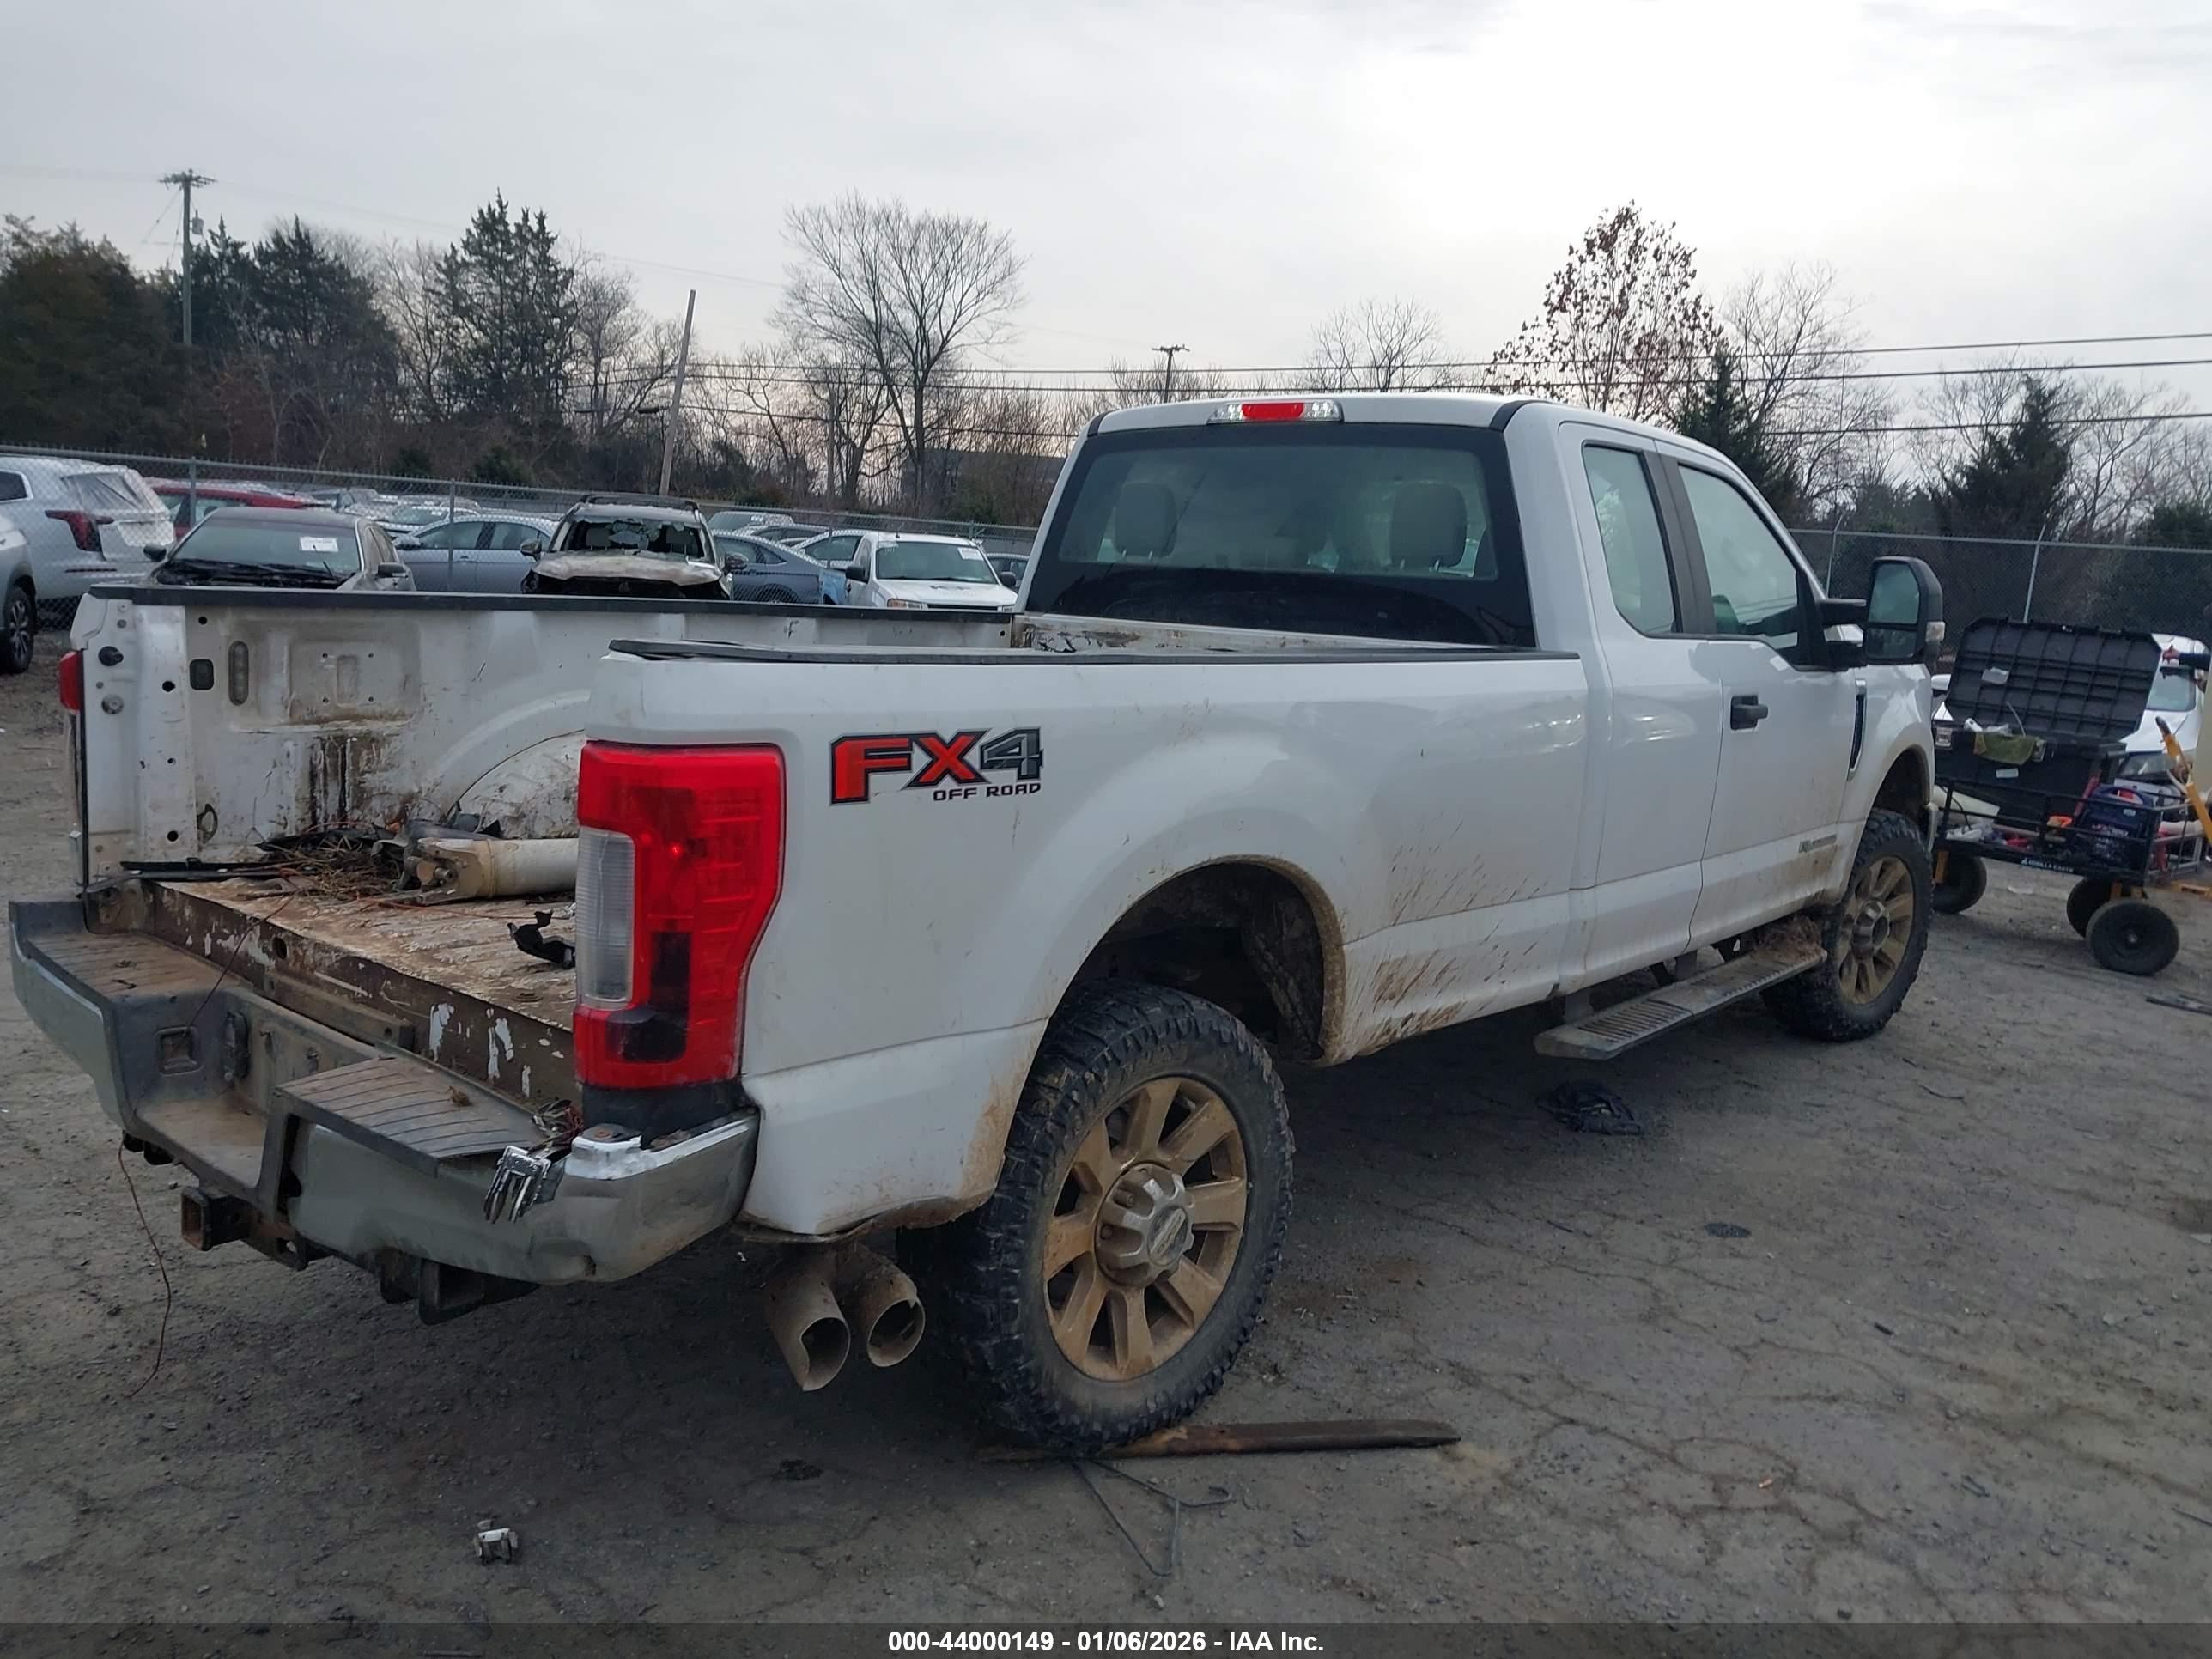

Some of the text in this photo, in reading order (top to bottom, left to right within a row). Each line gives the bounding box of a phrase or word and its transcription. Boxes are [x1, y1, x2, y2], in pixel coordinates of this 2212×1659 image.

[830, 727, 1042, 804] FX4
[933, 782, 1041, 801] OFF ROAD
